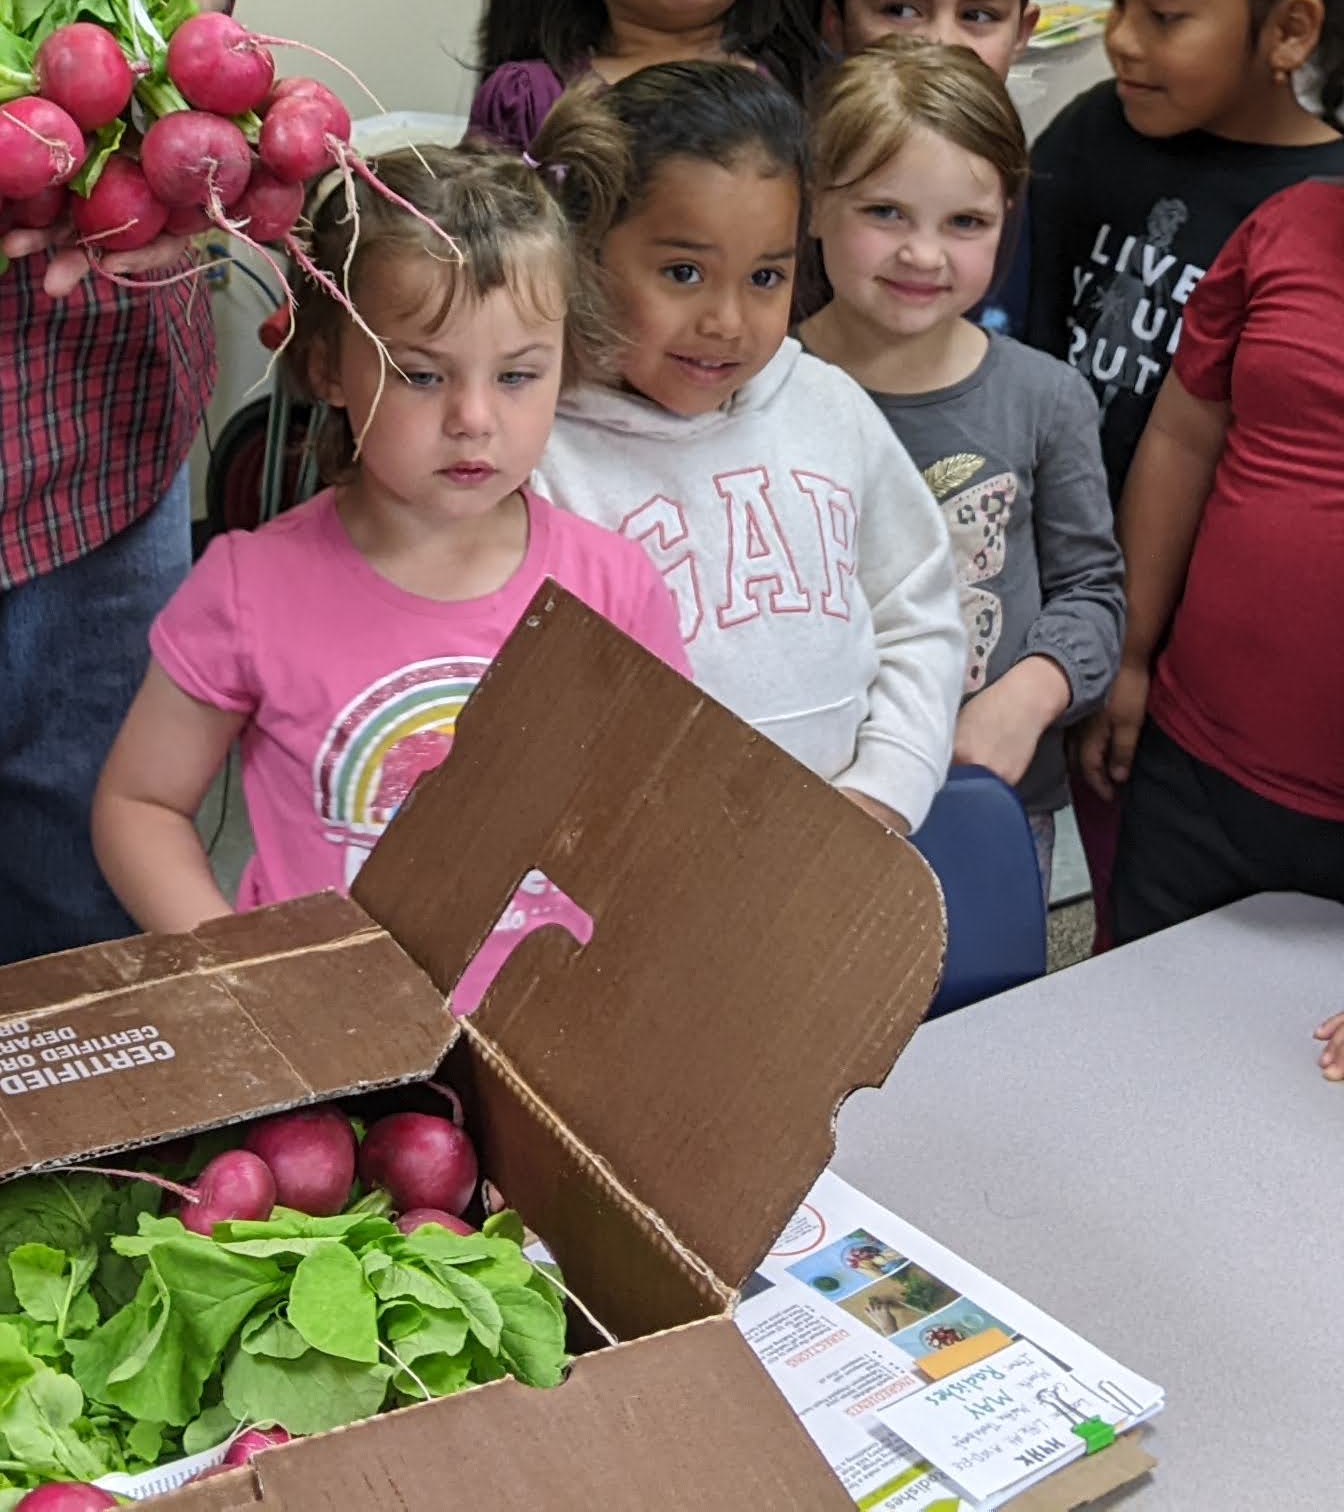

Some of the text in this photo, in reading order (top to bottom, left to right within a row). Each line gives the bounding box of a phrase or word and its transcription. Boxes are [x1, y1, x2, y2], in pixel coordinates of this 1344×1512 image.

[1090, 224, 1206, 305] LIVE
[617, 464, 858, 647] GAP
[40, 1025, 160, 1063] CERTIFIED
[785, 1328, 850, 1368] DIRECTIONS
[846, 1374, 917, 1417] INGREDIENTS
[925, 1364, 1007, 1407] Radishes
[964, 1388, 1014, 1421] MAY
